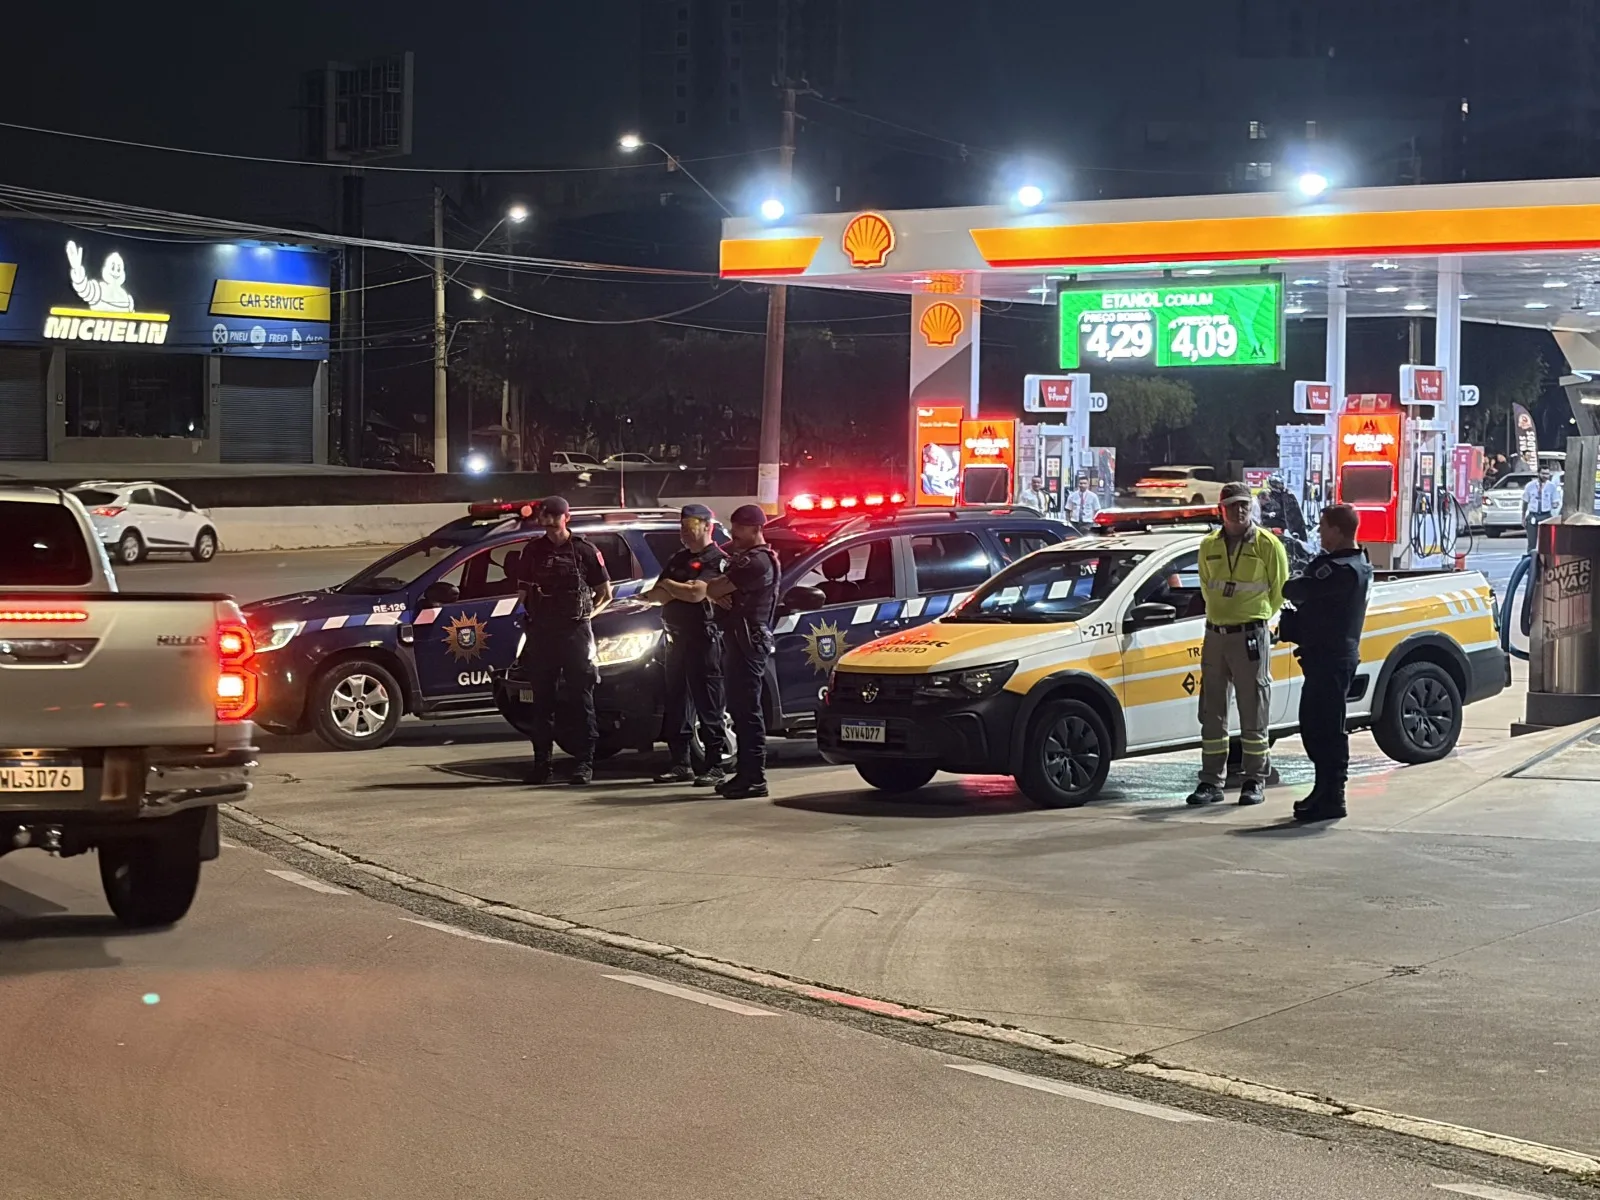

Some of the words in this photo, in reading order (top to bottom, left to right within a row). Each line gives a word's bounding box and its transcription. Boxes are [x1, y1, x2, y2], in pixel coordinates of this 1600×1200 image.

[240, 294, 261, 308] CAR
[264, 295, 304, 311] SERVICE
[1102, 293, 1163, 309] ETANOL
[44, 317, 168, 344] MICHELIN
[230, 332, 248, 341] PNEU
[269, 333, 288, 343] FREIO
[1087, 324, 1151, 362] 4,29
[1171, 324, 1237, 362] 4,09
[1091, 397, 1105, 408] 10
[1461, 389, 1477, 402] 12
[1545, 559, 1590, 581] OWER
[1560, 572, 1588, 590] VAC
[373, 602, 406, 613] RE-126
